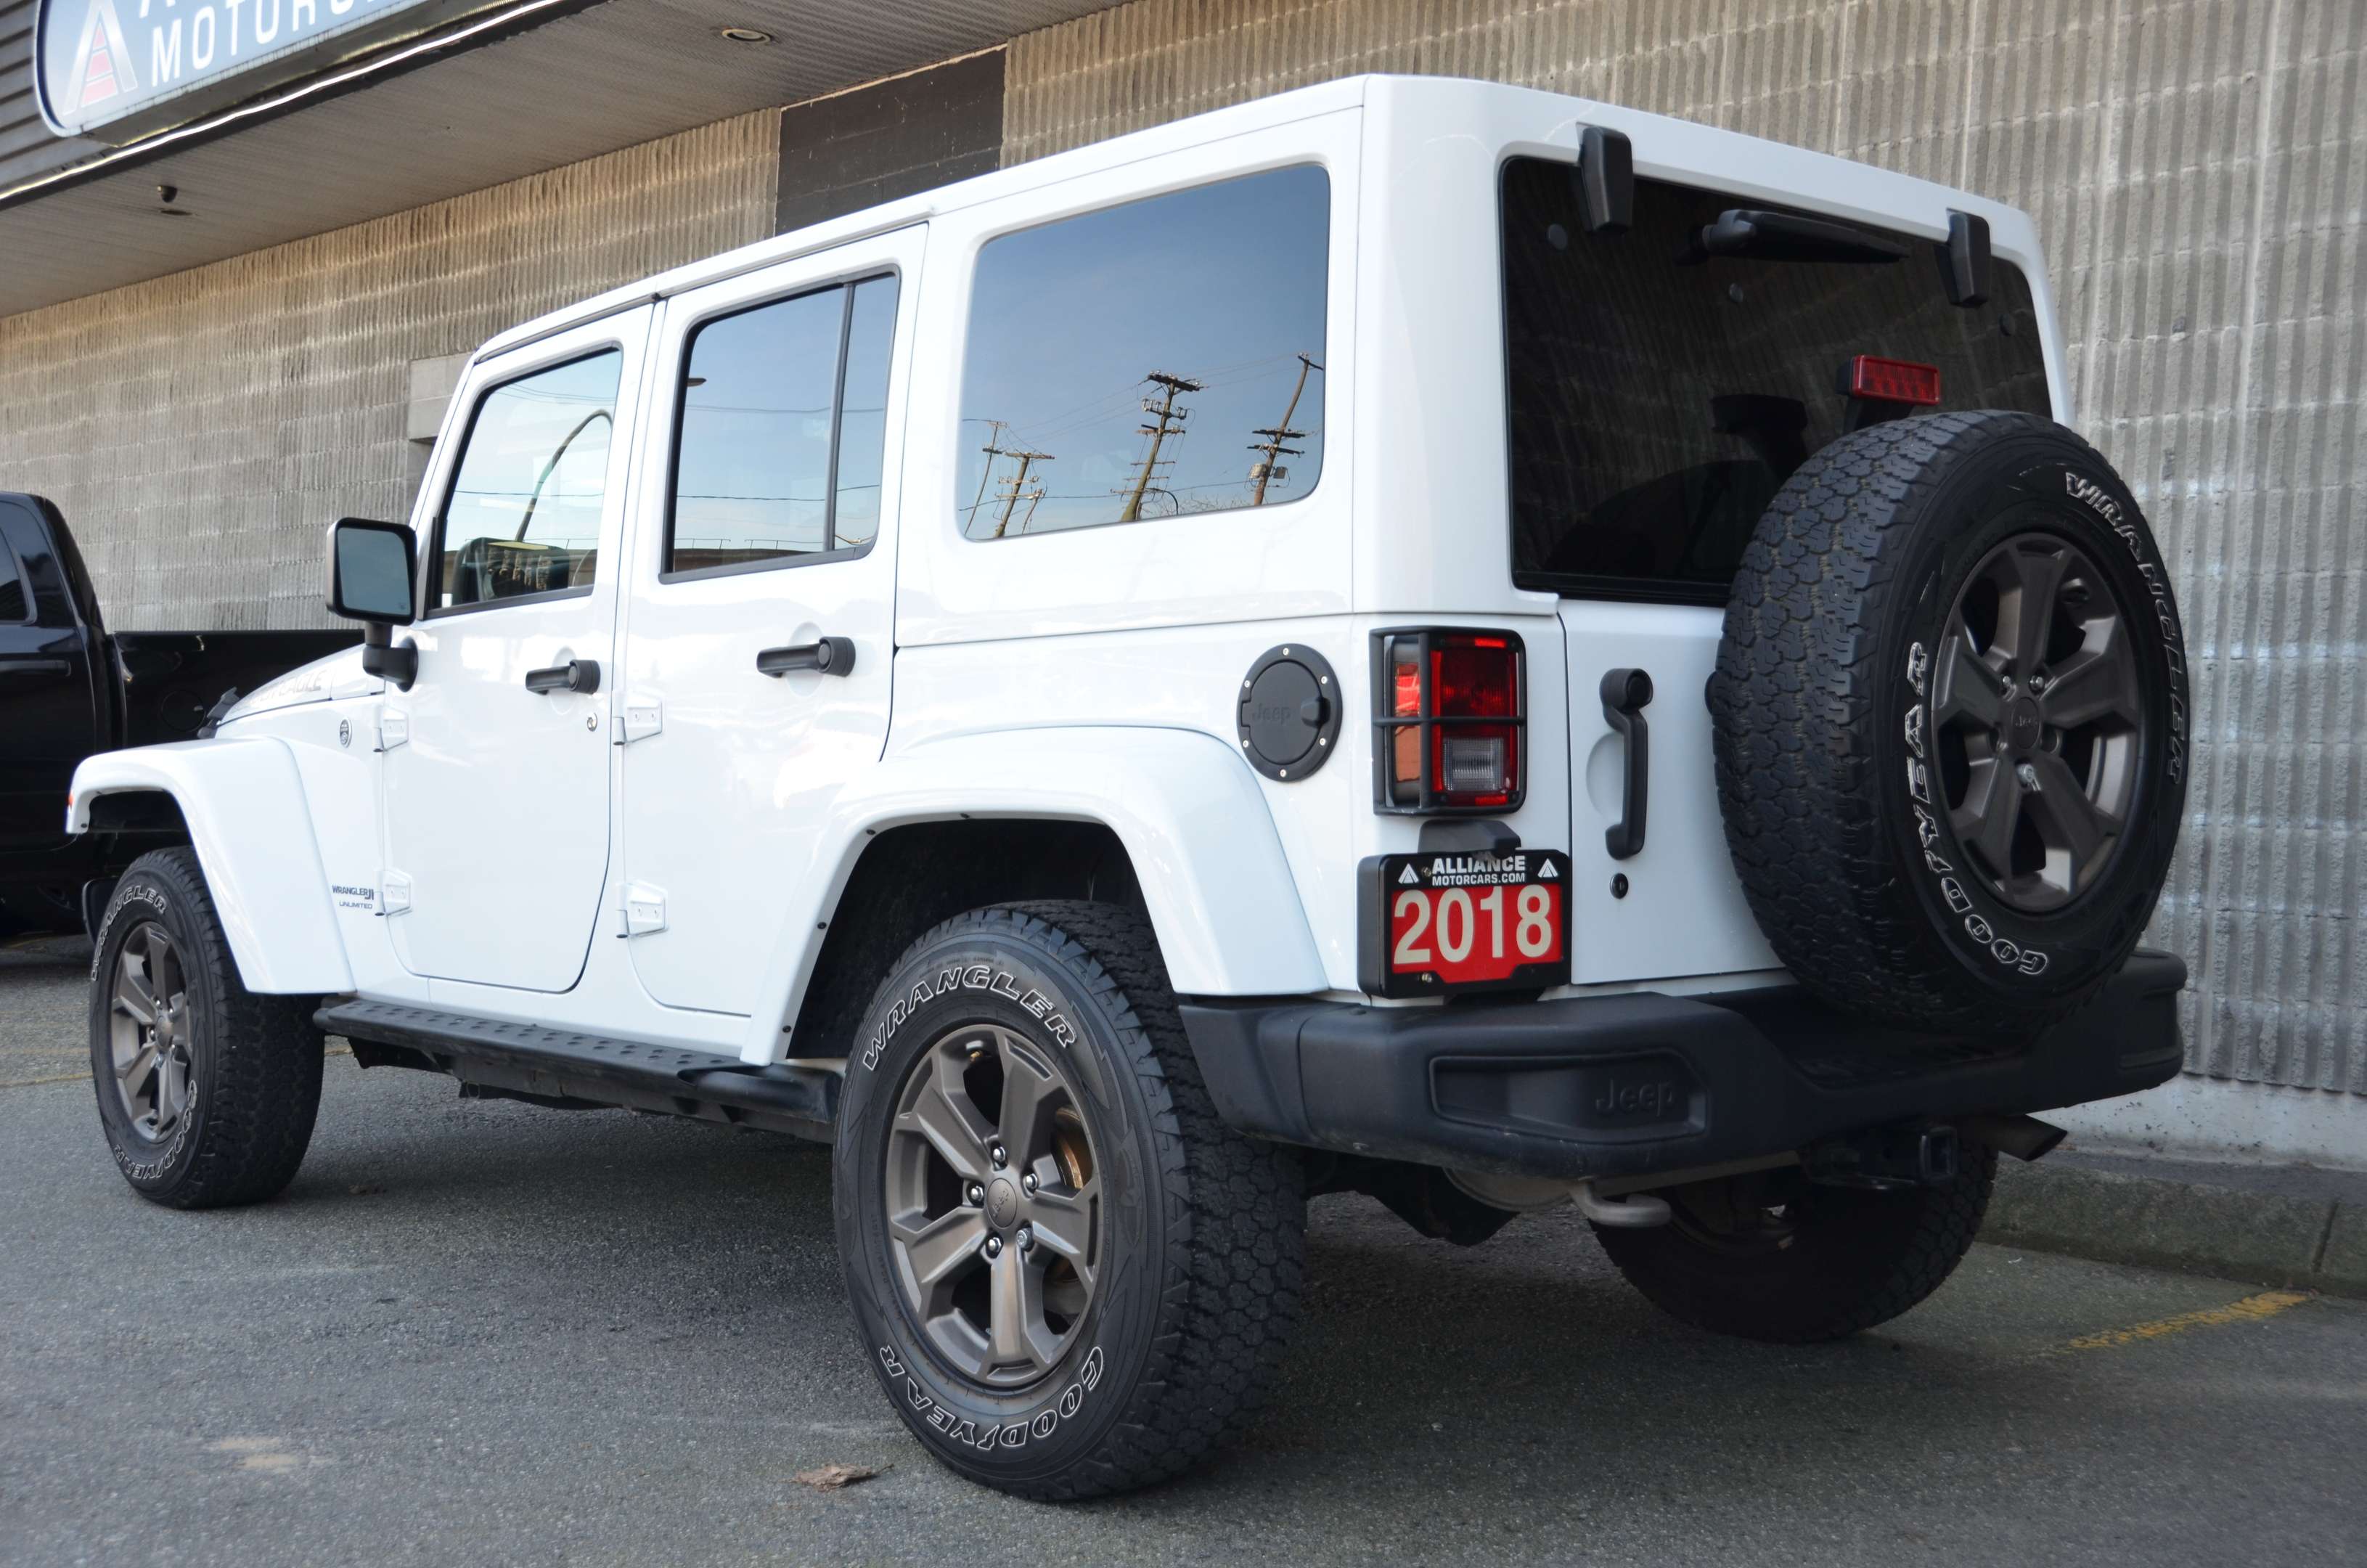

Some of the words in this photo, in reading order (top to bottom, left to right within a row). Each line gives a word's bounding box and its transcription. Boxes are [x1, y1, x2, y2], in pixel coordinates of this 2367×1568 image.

[2066, 472, 2185, 784] WRANGLER
[1251, 702, 1291, 725] Jeep
[1905, 642, 2048, 976] GOODYEAR
[332, 885, 369, 897] WRANGLER
[339, 901, 373, 910] UNLIMITED
[1431, 855, 1526, 875] ALLIANCE
[1431, 873, 1526, 886] MOTORCARS.COM
[91, 885, 166, 981] WRANGLER
[1394, 884, 1552, 965] 2018
[862, 965, 1077, 1071] WRANGLER
[114, 1079, 198, 1180] GOODYEAR
[1595, 1078, 1673, 1117] Jeep
[879, 1345, 1104, 1450] GOODYEAR
